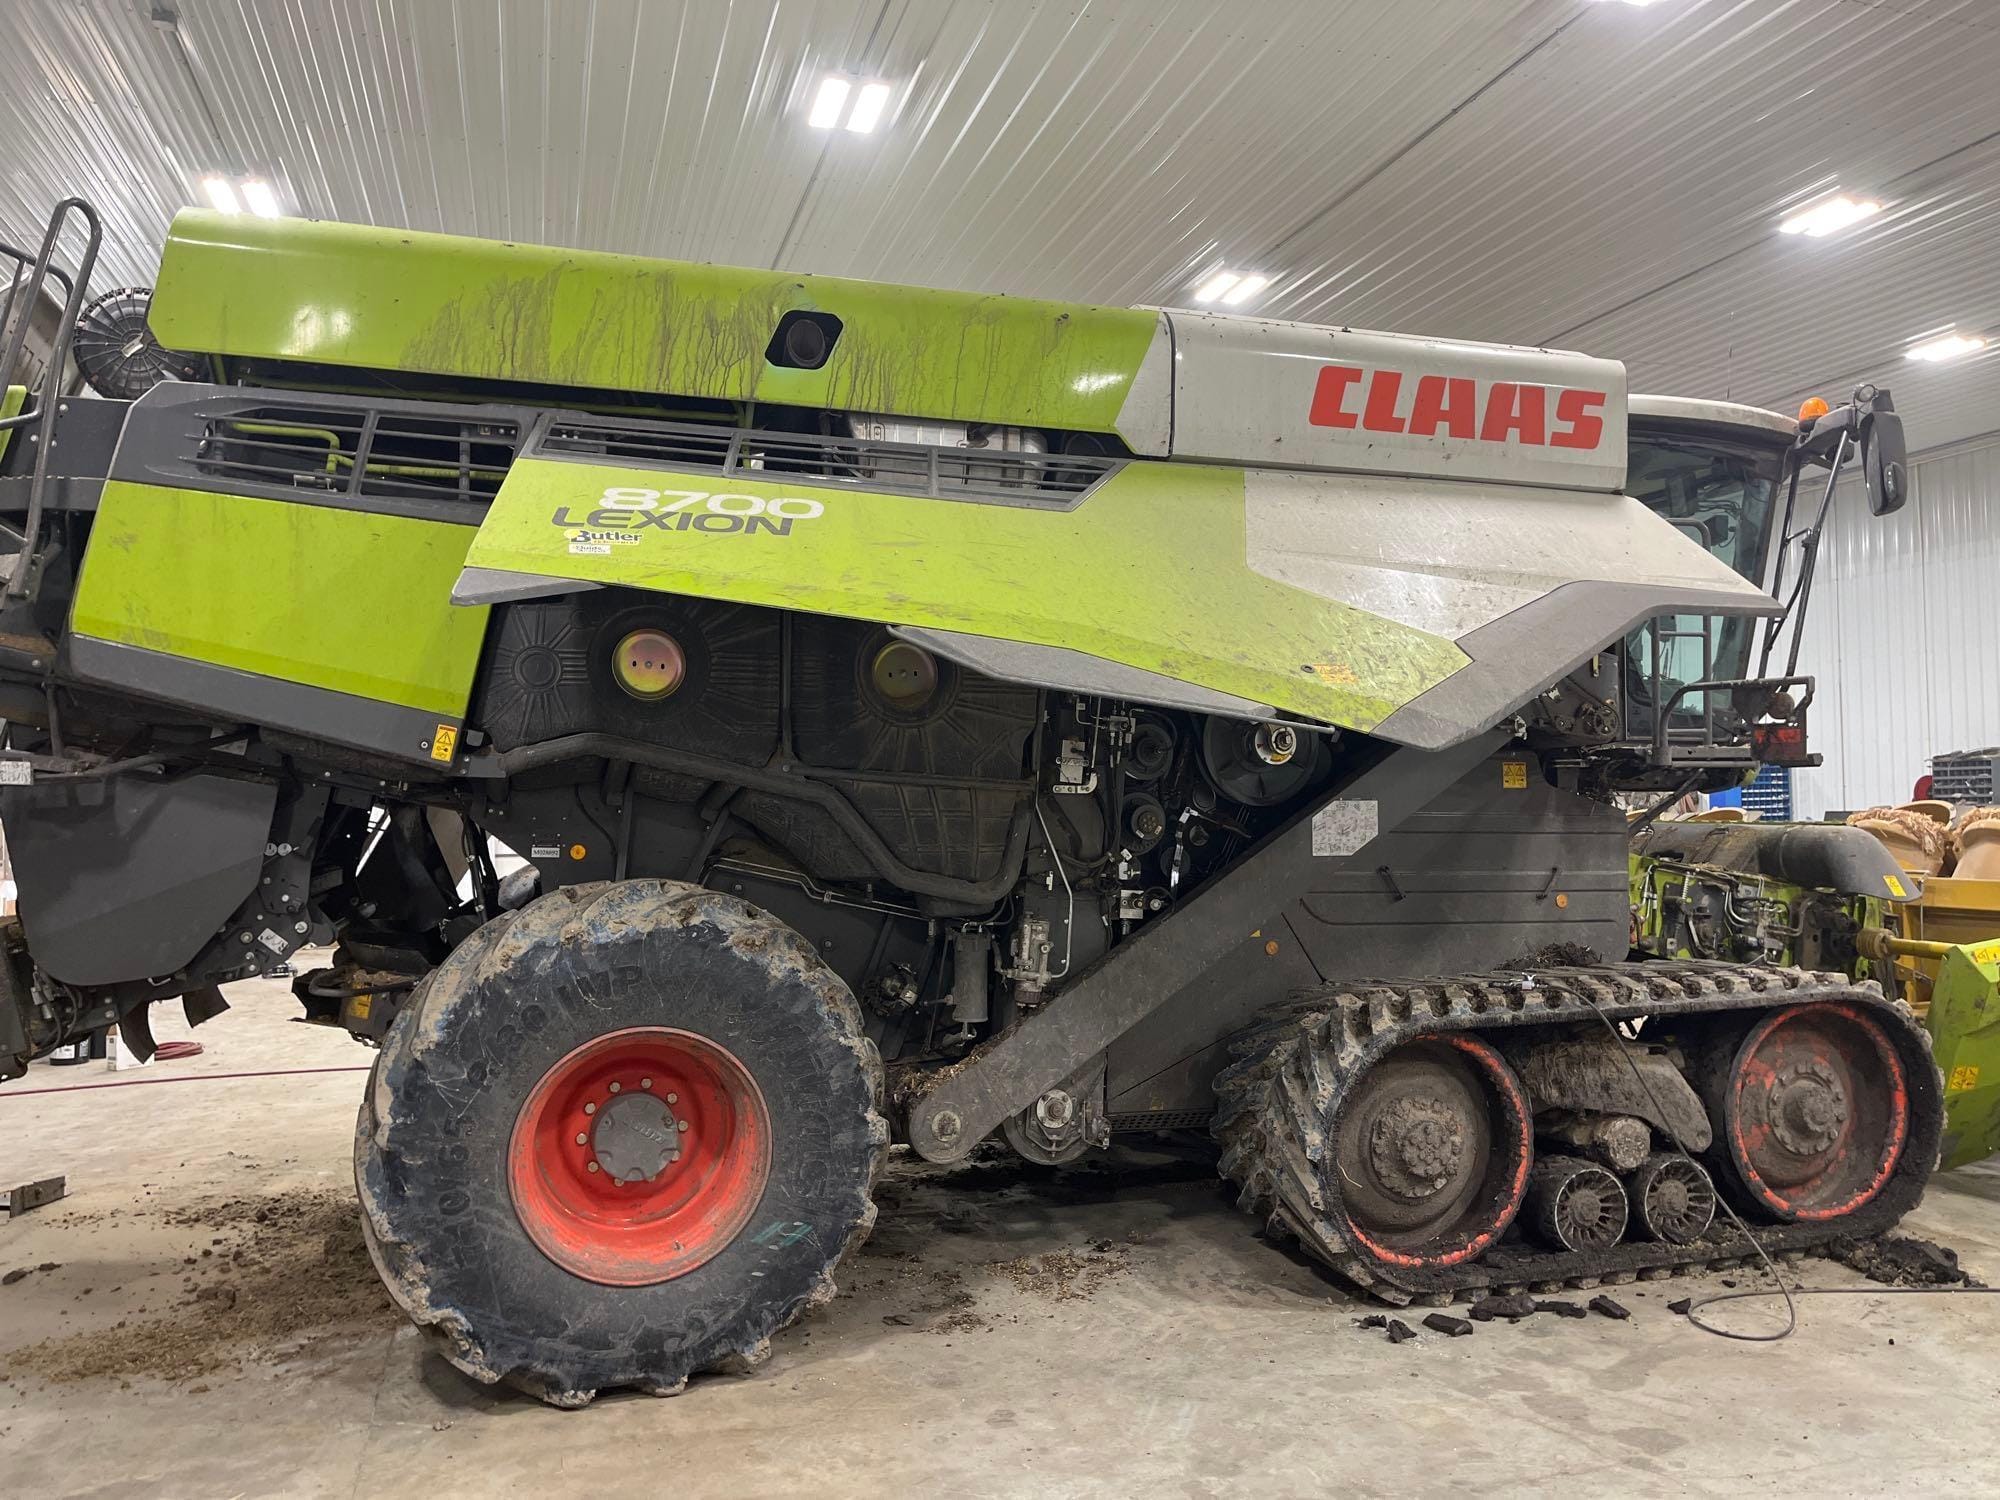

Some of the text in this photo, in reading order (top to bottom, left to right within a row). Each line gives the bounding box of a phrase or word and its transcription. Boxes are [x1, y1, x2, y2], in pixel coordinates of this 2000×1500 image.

[1309, 365, 1607, 449] CLAAS
[599, 487, 825, 519] 8700
[551, 506, 794, 536] LEXION
[570, 530, 643, 542] Butler
